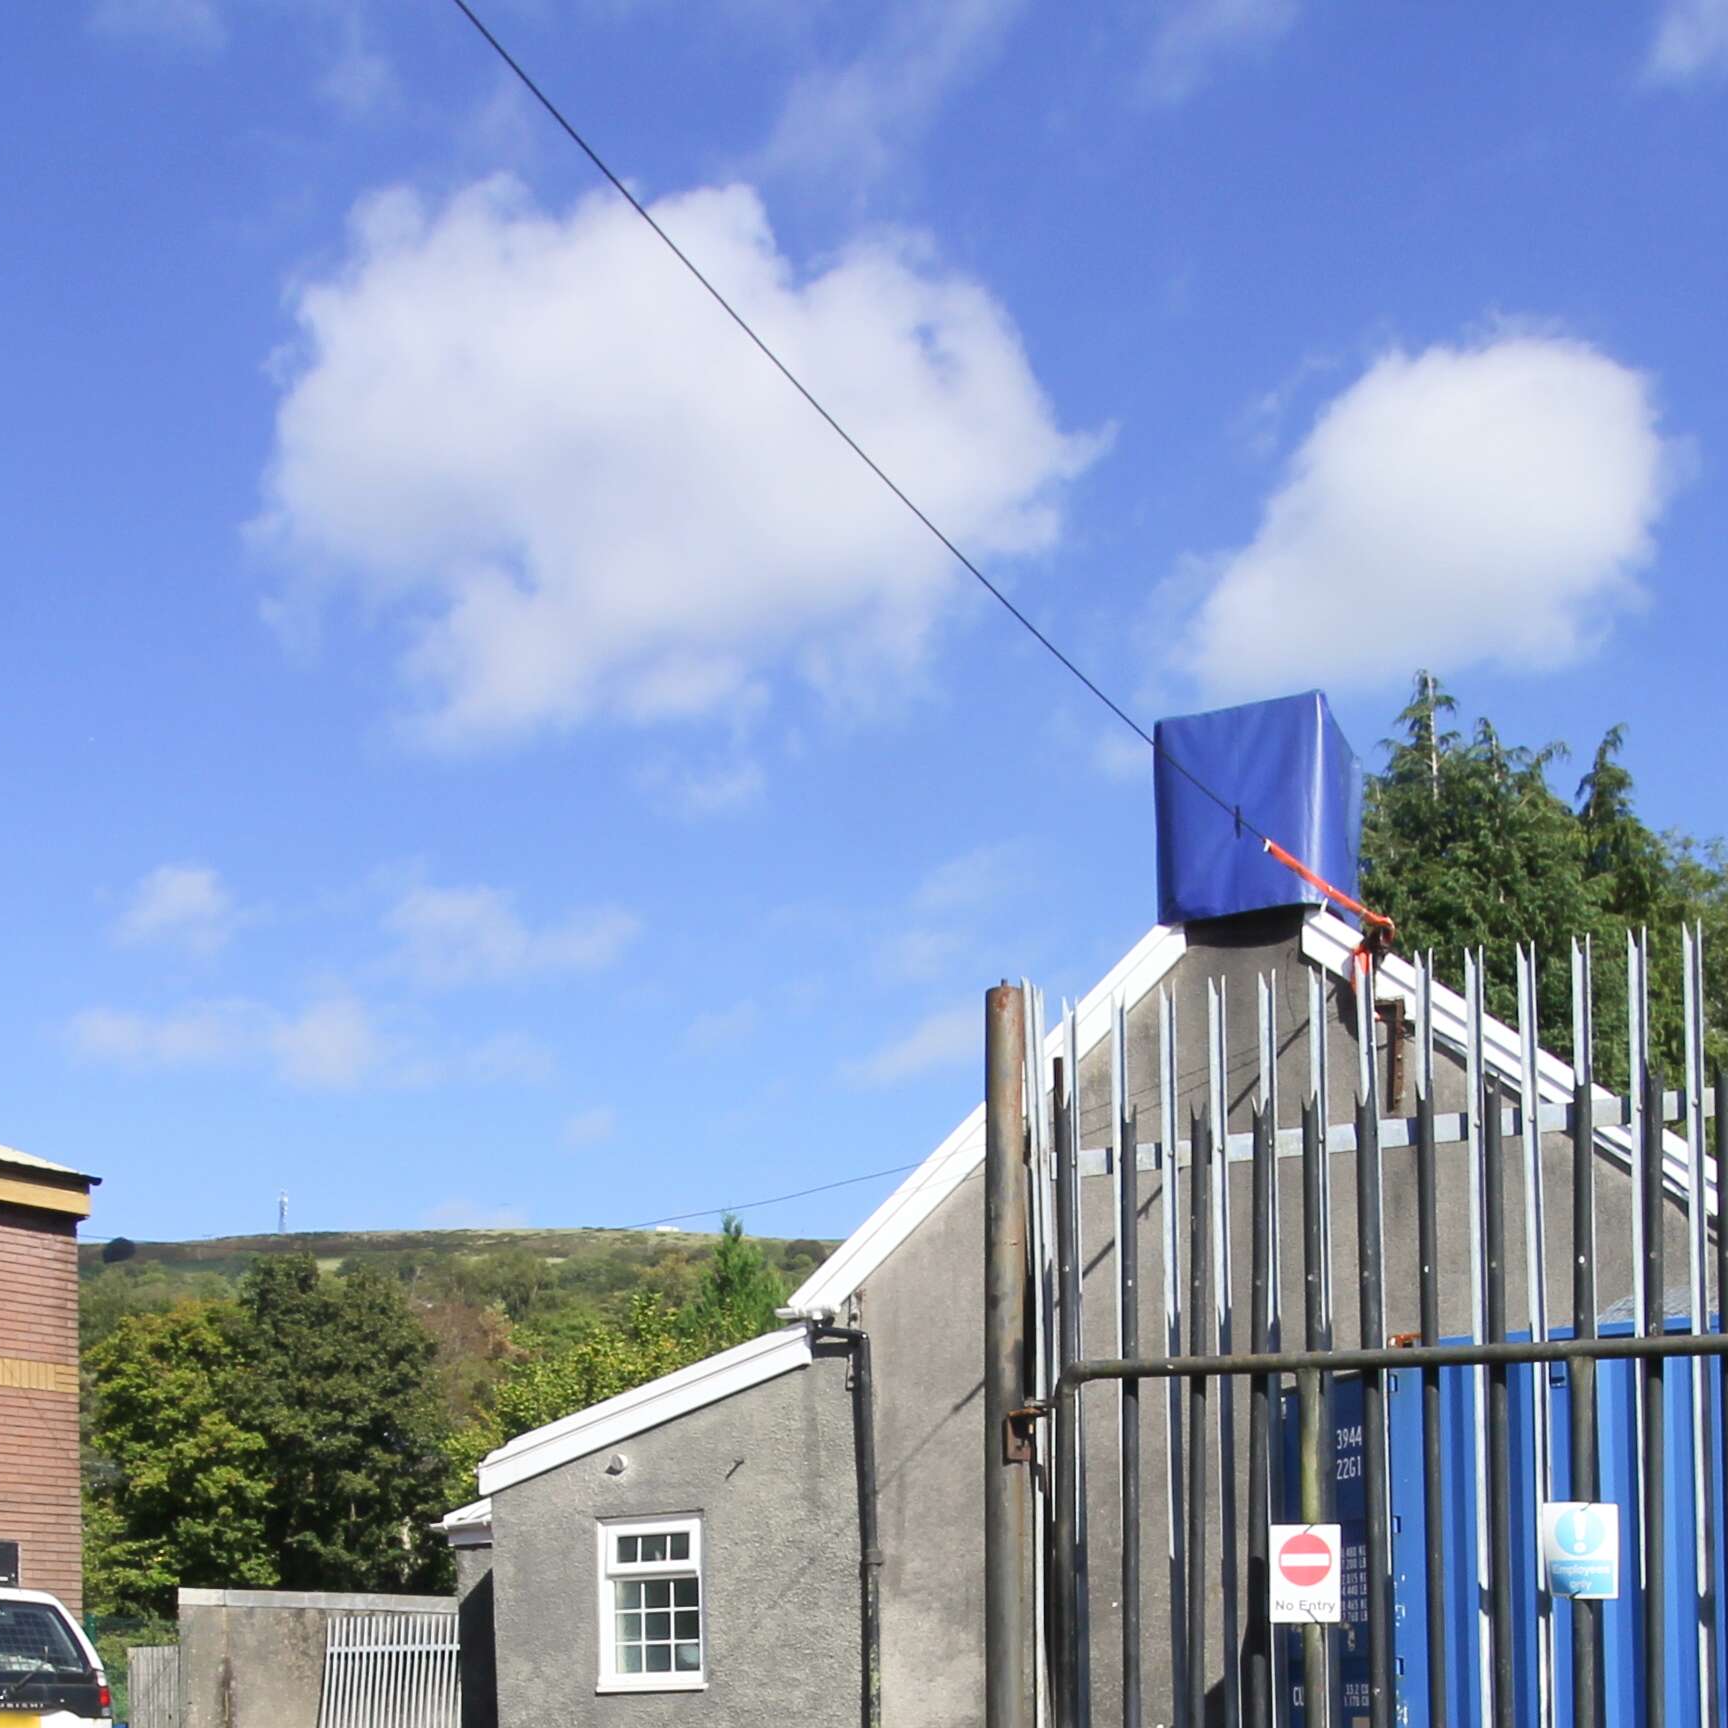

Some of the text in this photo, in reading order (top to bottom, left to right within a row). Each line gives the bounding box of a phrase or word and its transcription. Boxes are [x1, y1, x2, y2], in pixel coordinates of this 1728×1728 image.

[1336, 1456, 1361, 1480] 22G1
[1275, 1600, 1336, 1613] No Entry
